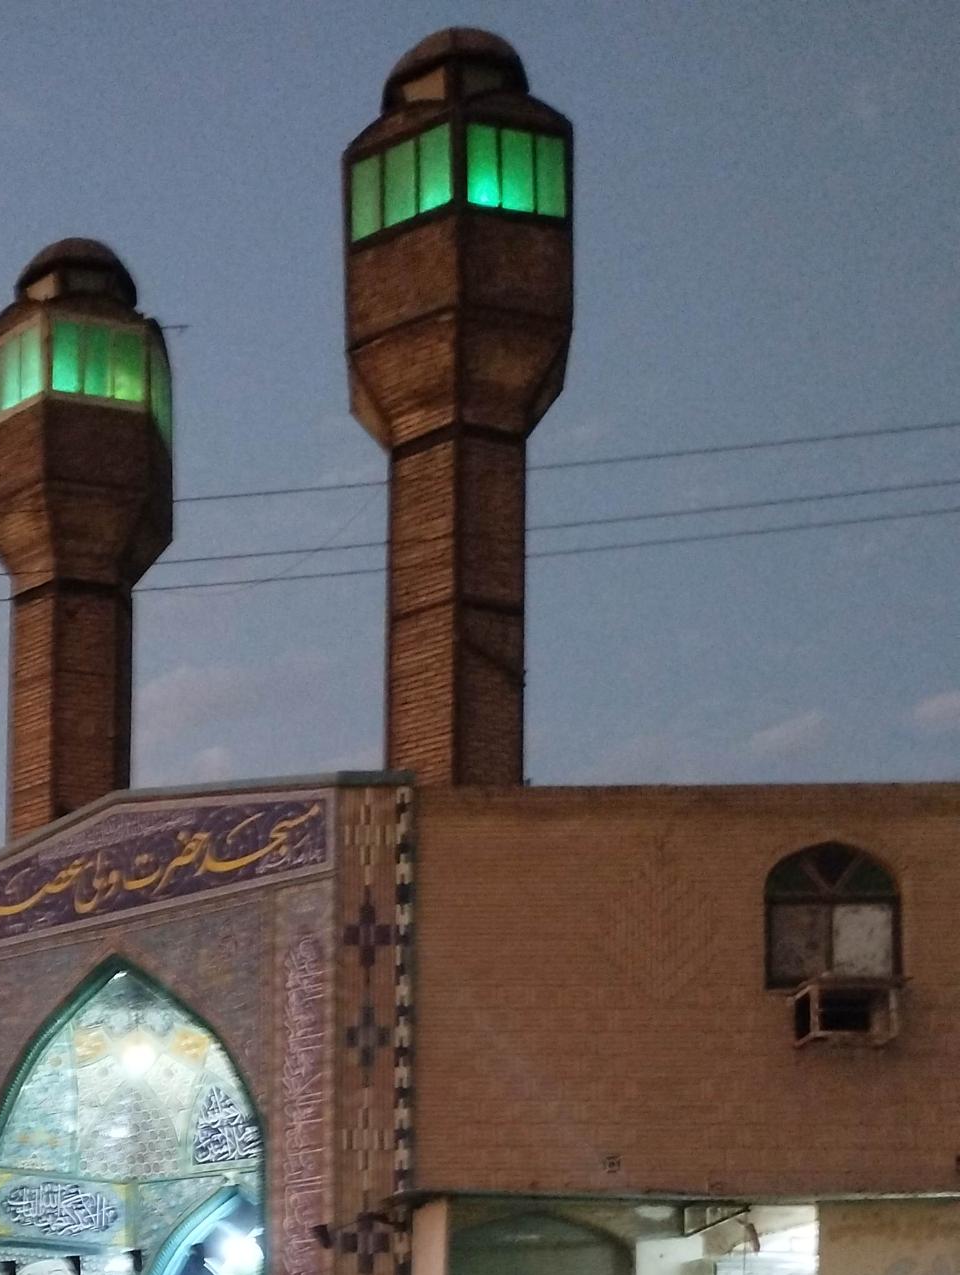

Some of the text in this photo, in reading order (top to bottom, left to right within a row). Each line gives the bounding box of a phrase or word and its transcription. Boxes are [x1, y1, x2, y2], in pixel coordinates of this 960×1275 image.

[123, 827, 212, 897] حضرت
[197, 801, 322, 877] مسجد
[74, 850, 123, 914] ولی
